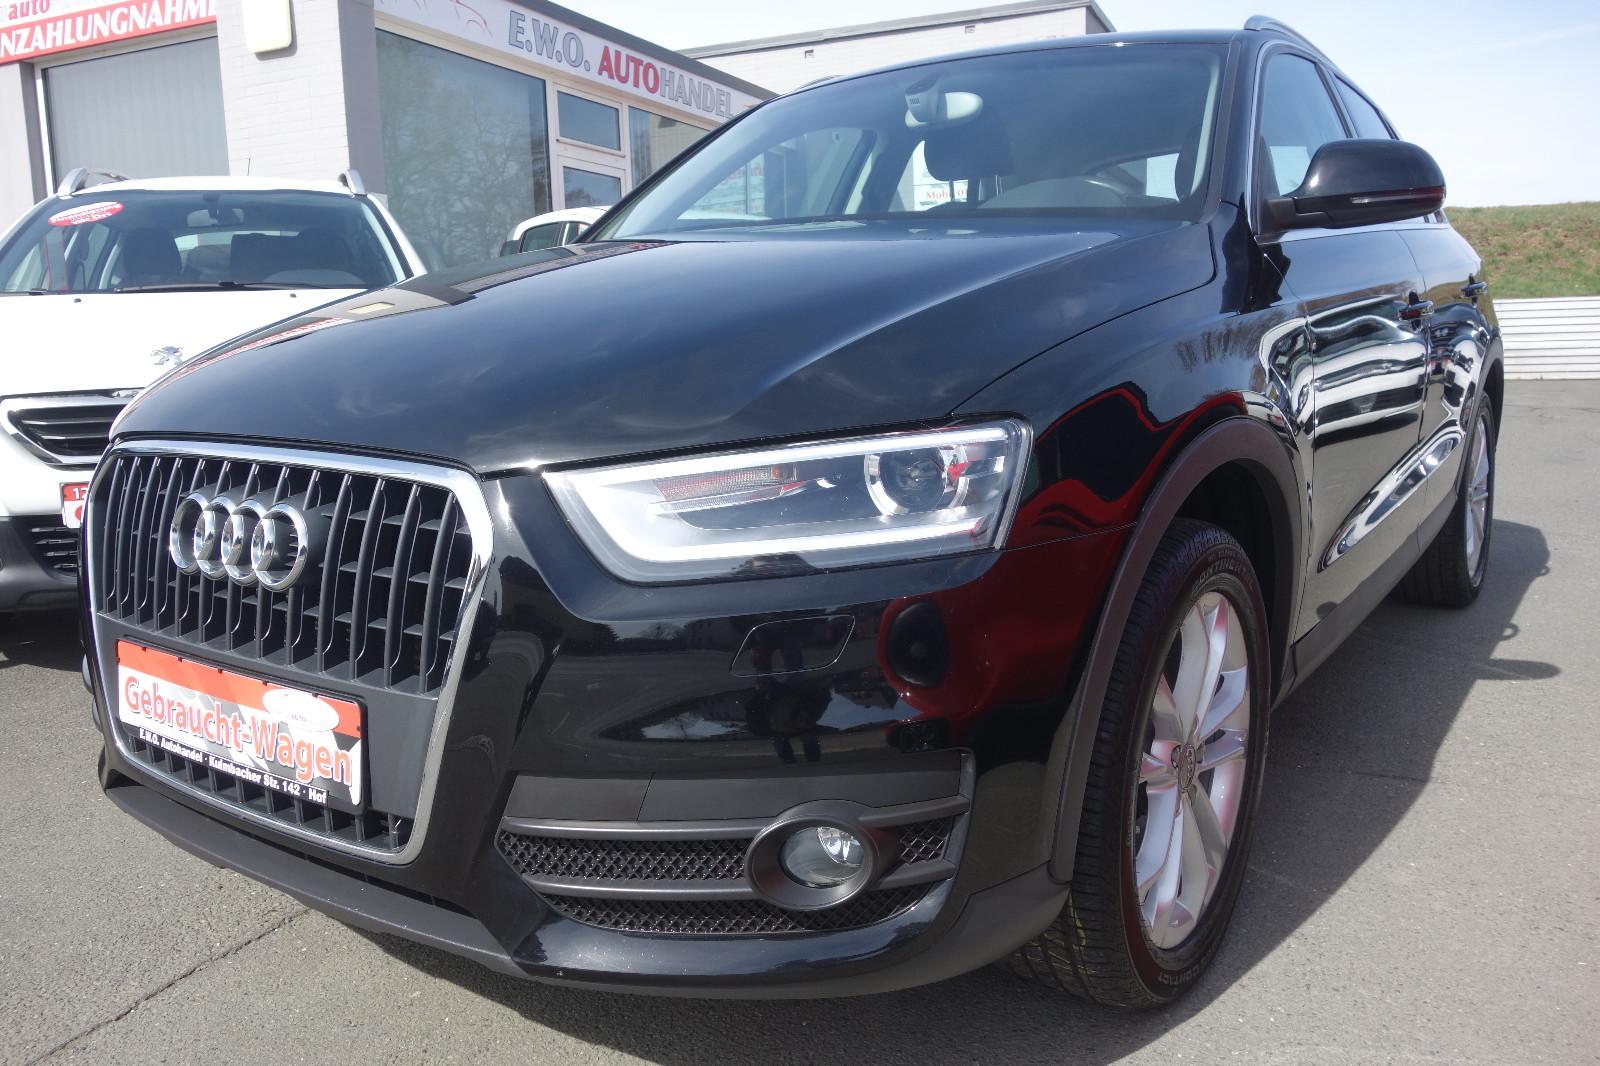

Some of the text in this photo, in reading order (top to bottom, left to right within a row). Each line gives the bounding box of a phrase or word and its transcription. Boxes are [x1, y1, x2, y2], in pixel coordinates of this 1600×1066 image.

[508, 10, 736, 118] E.W.O. AUTOHANDEL
[124, 676, 353, 786] Gebraucht-Wagen
[161, 737, 203, 763] Autohandel
[209, 756, 262, 784] Kulmbacher
[263, 775, 280, 790] Str.
[282, 781, 301, 797] 142
[308, 788, 328, 804] Hof
